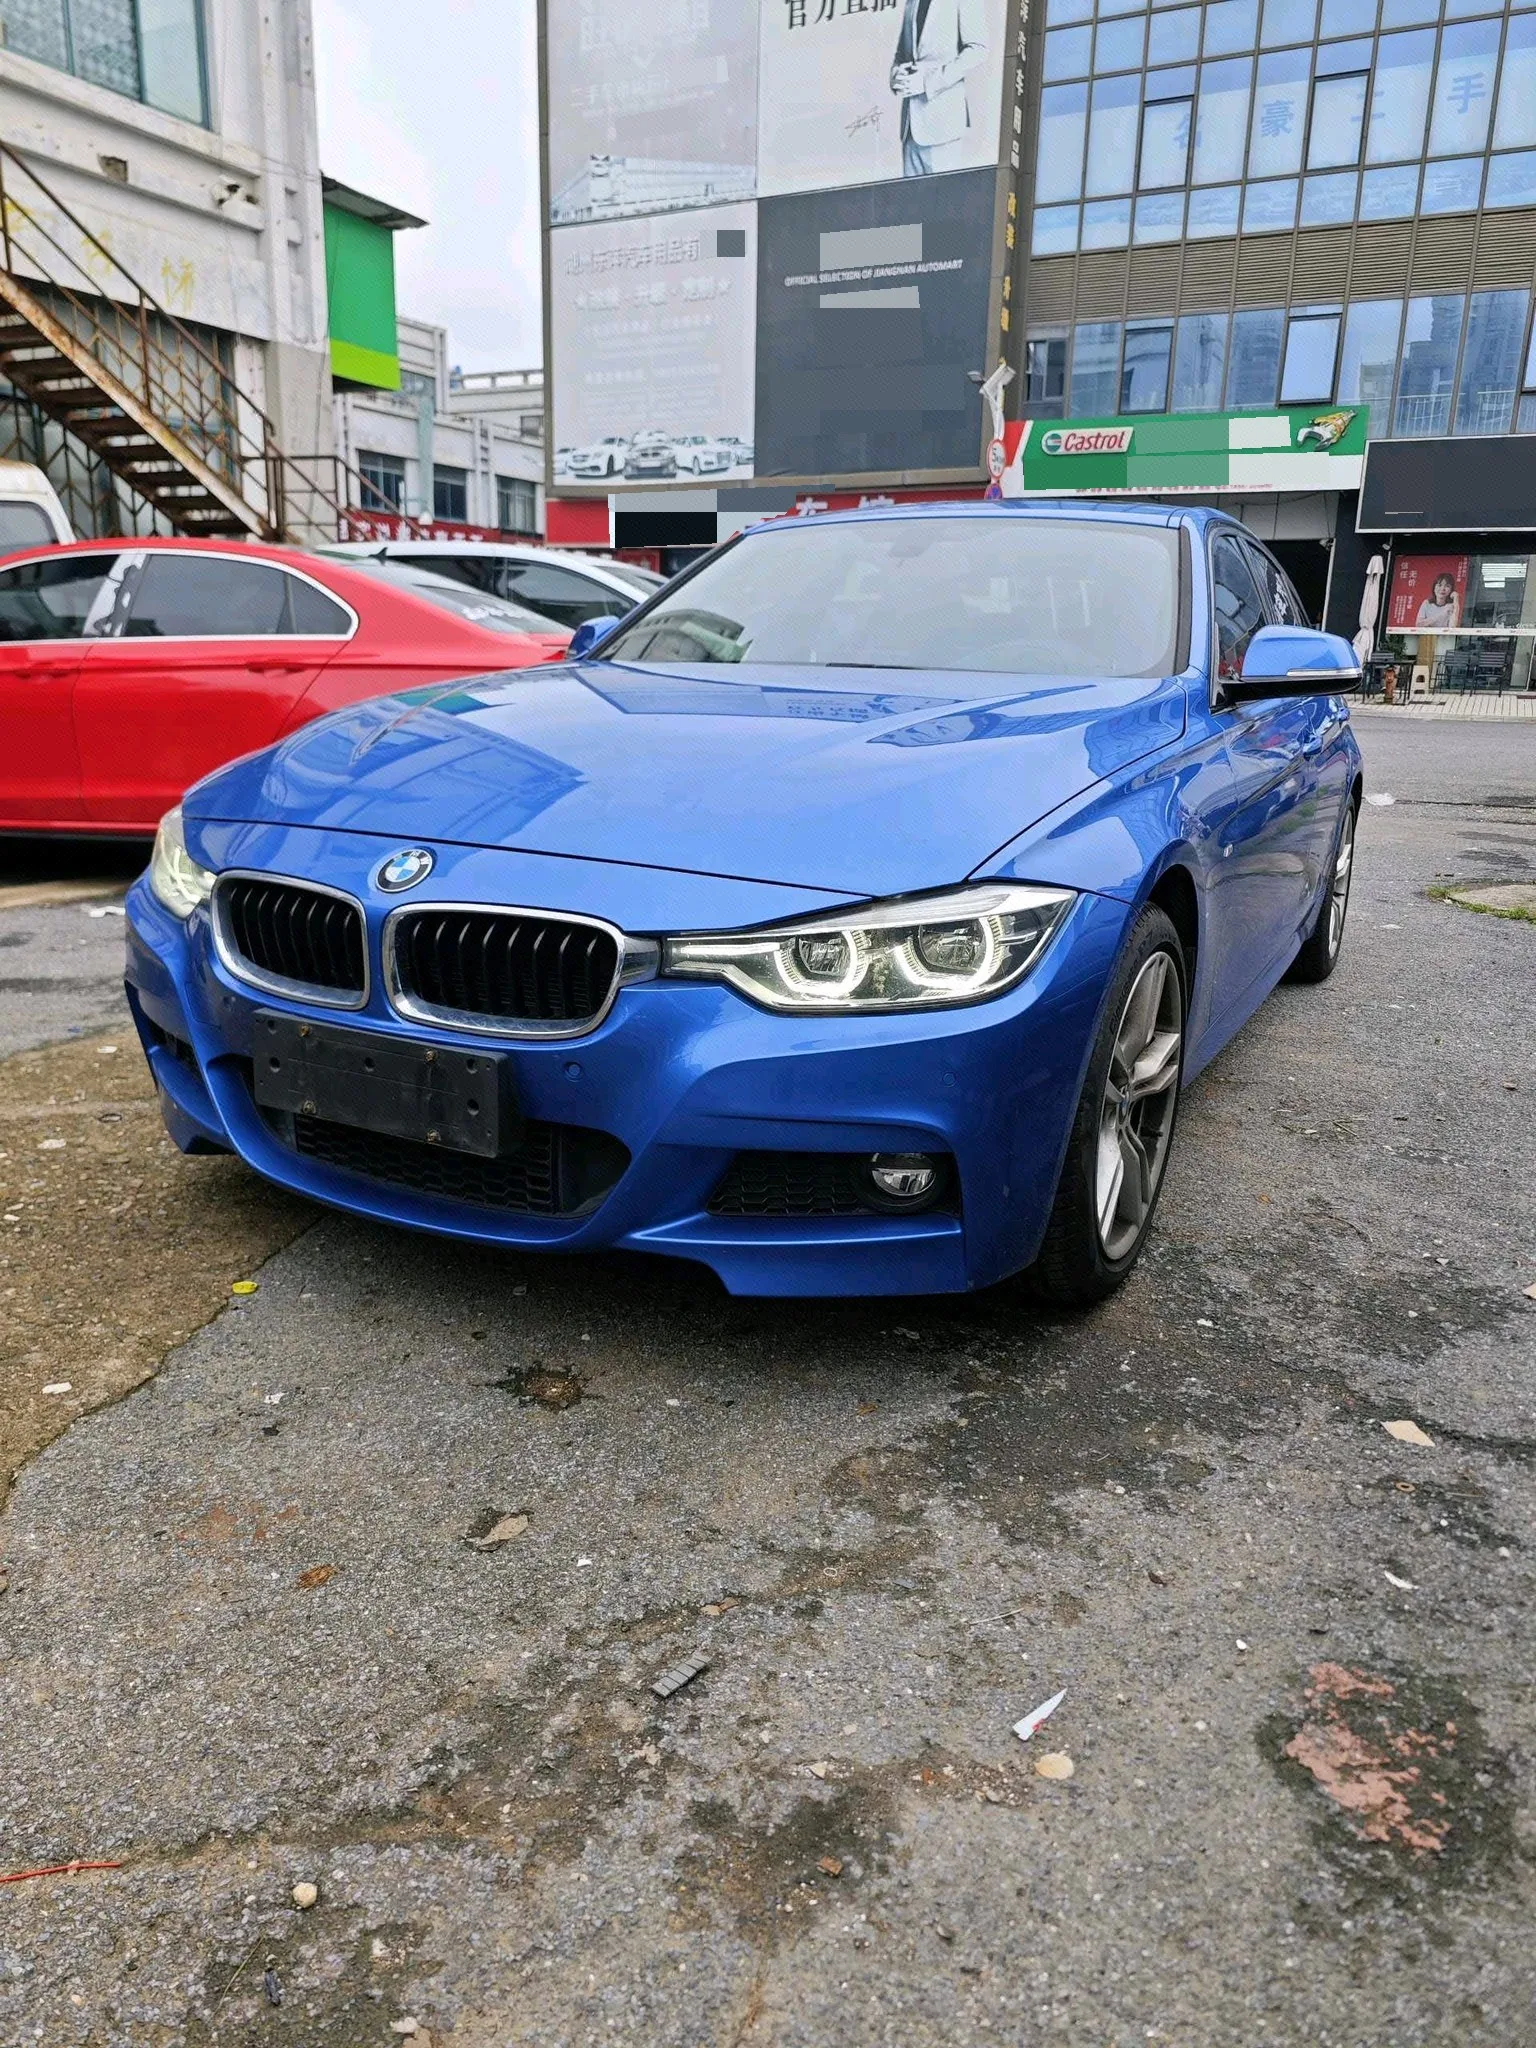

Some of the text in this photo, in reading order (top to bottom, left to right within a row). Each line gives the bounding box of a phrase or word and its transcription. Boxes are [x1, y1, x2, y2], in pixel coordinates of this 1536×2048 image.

[819, 269, 861, 284] SELECTION
[861, 269, 873, 279] OF
[916, 259, 963, 273] AUTOMART
[1064, 431, 1126, 452] Castrol
